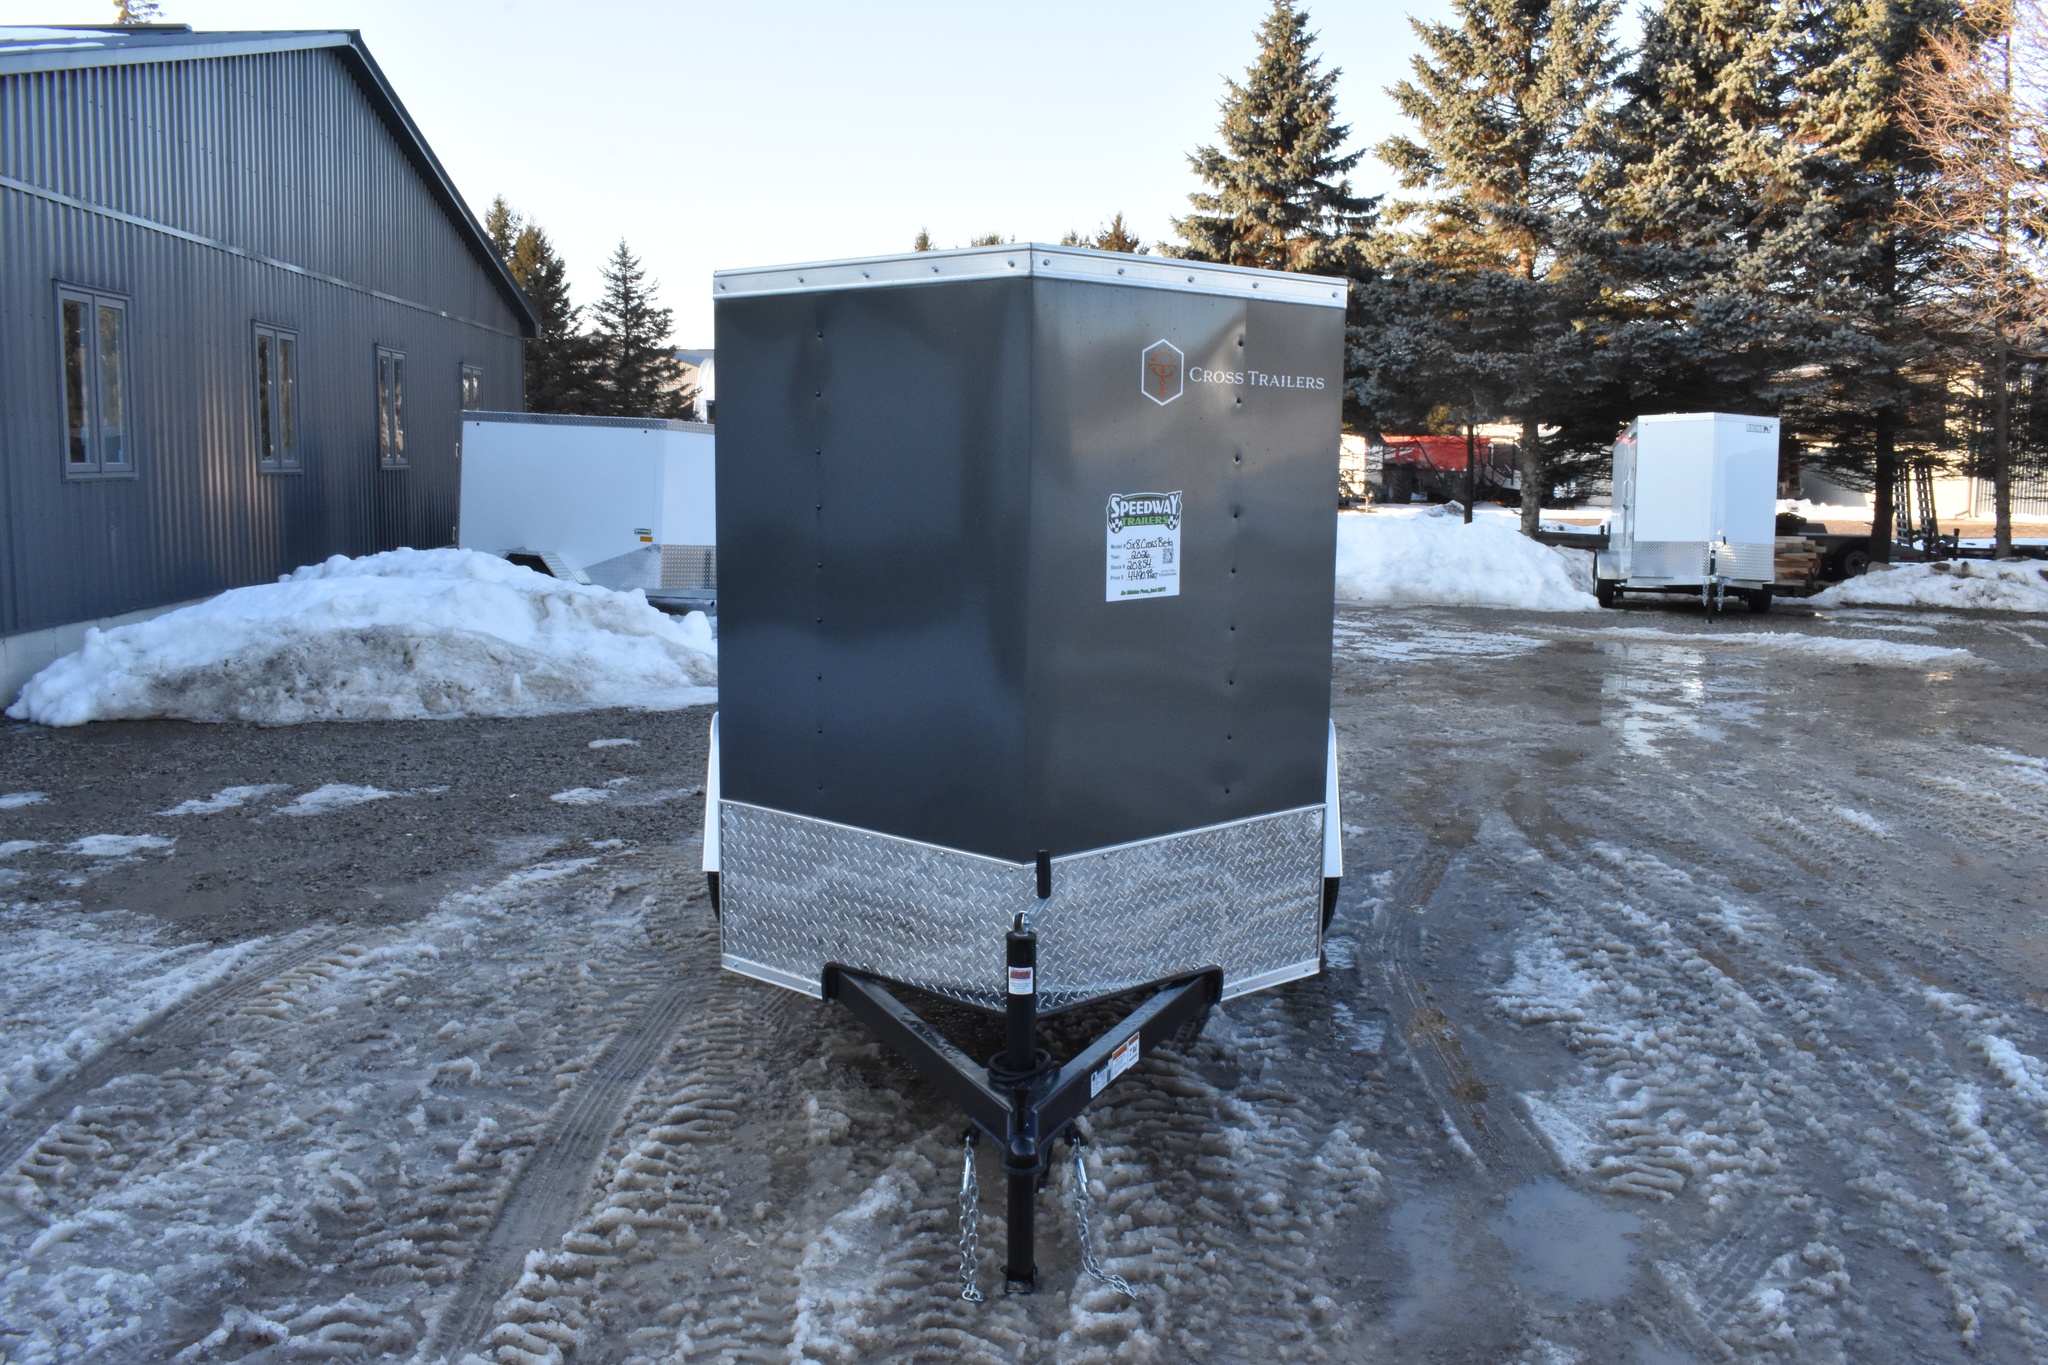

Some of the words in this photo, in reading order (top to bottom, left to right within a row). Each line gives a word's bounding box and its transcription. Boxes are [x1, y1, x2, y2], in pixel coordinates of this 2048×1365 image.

[1189, 367, 1244, 385] CROSS
[1247, 370, 1325, 390] TRAILERS
[1110, 494, 1179, 518] SPEEDWAY
[1121, 515, 1169, 526] TRAILERS
